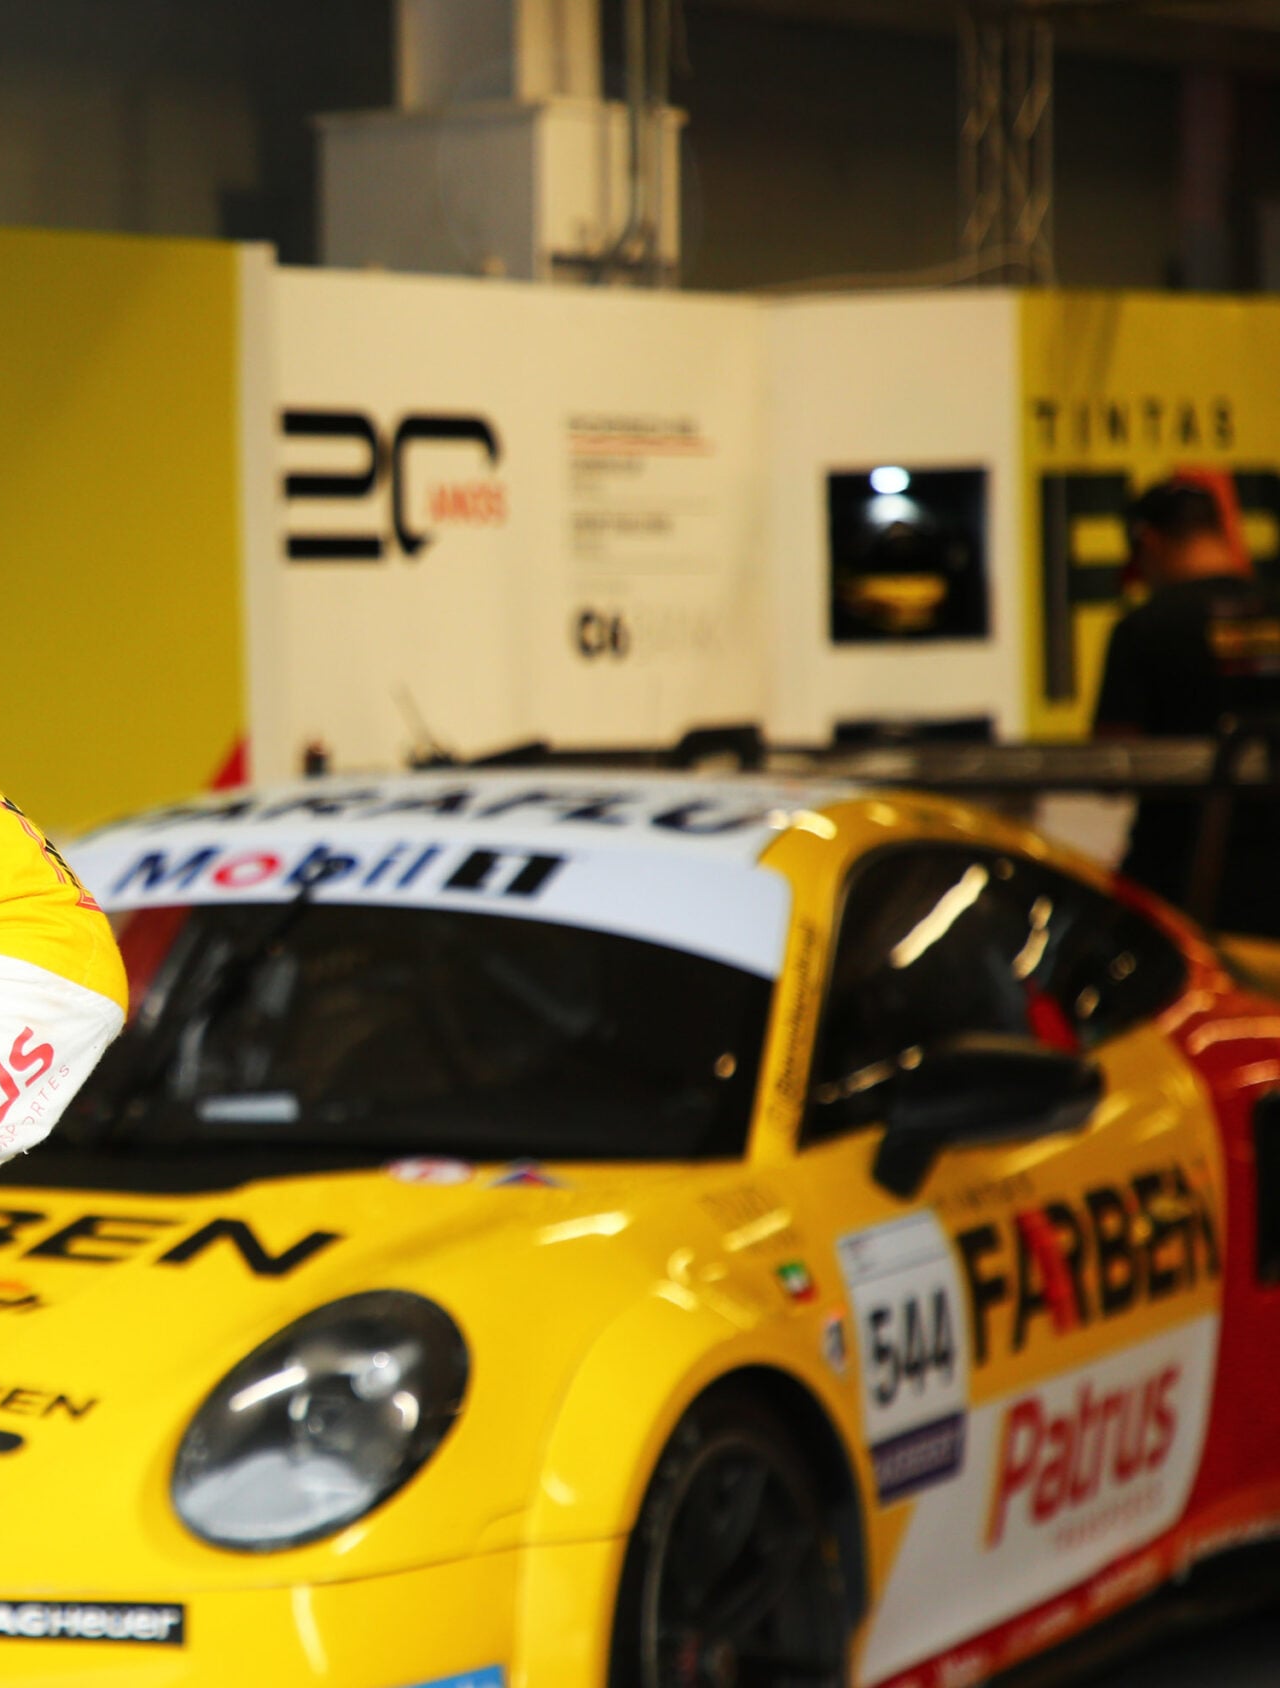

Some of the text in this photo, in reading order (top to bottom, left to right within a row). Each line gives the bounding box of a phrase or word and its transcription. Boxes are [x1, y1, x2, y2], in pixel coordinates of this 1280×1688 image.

[110, 845, 450, 896] Mobil
[869, 1287, 954, 1408] 544
[985, 1363, 1182, 1550] Patrus
